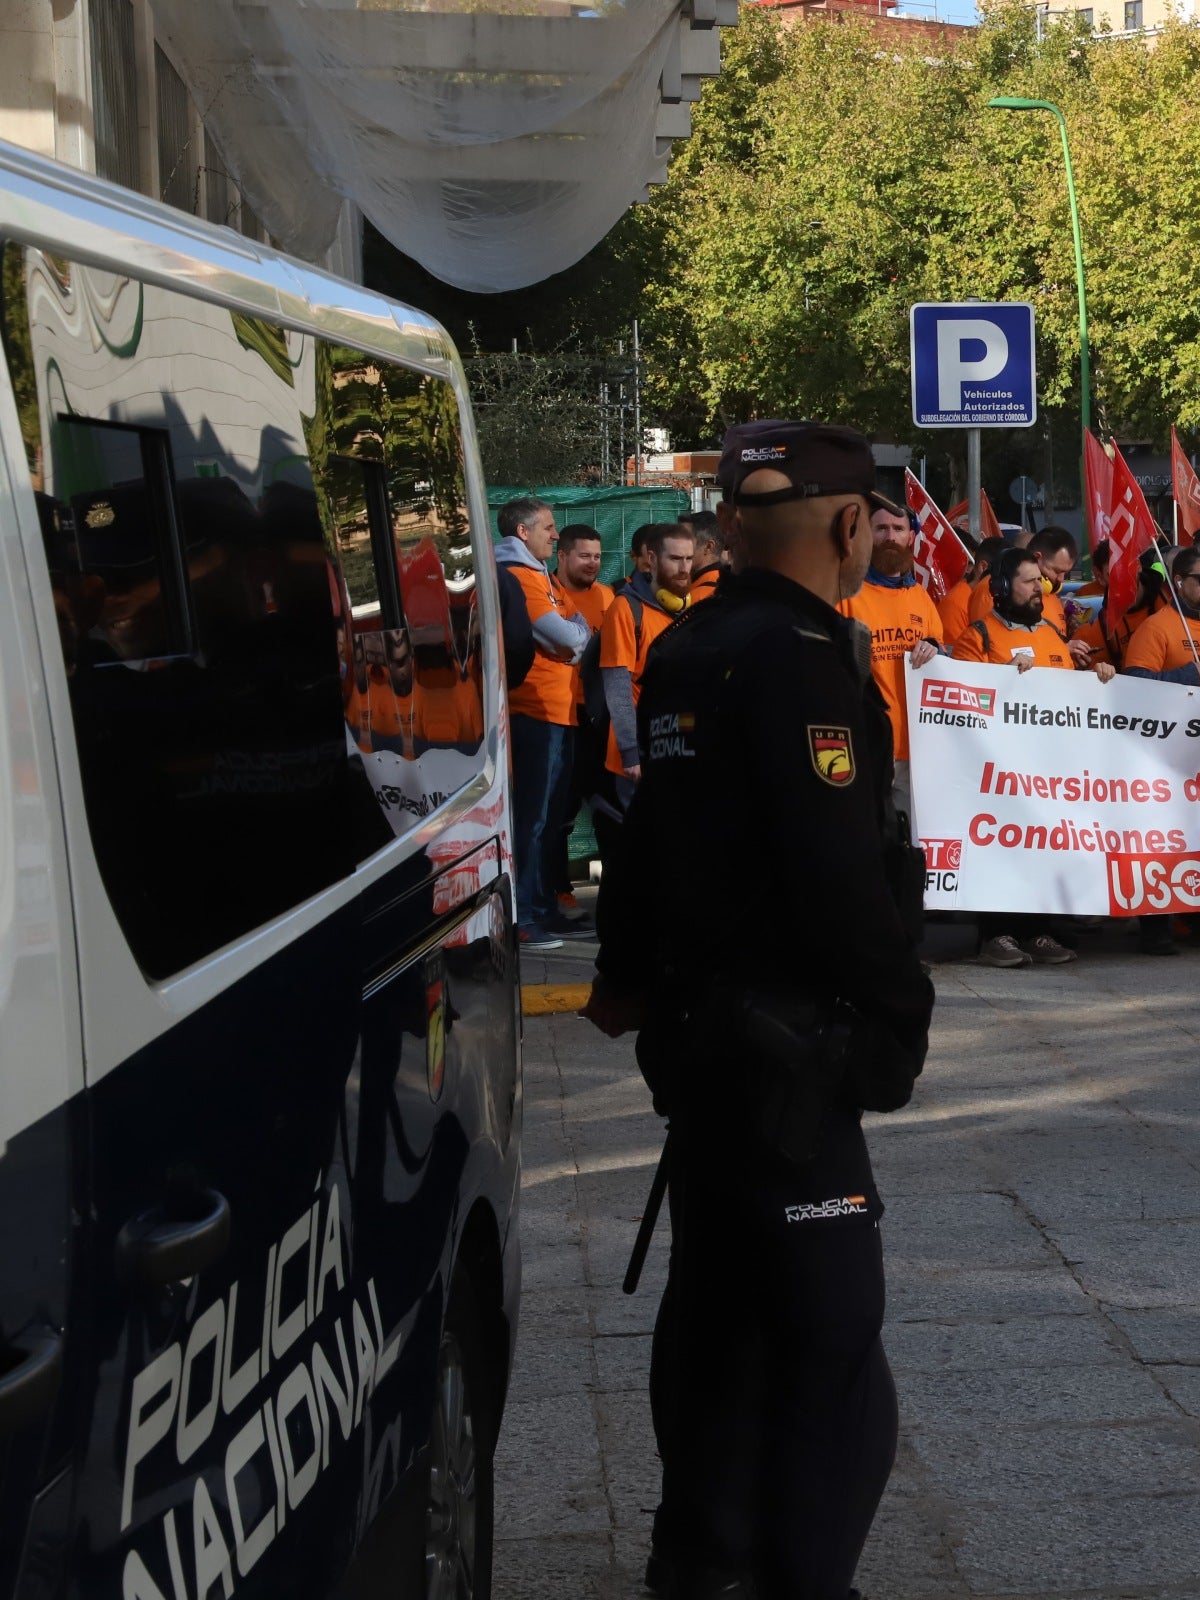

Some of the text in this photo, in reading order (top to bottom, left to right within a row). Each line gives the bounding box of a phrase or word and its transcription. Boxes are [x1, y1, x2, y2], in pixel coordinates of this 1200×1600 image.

[937, 319, 1008, 411] P
[964, 390, 1012, 399] Vehículos
[921, 412, 1028, 422] SUBDELEGACIÓN DEL GOBIERNO DE CÓRDOBA
[964, 402, 1025, 411] Autorizados
[926, 684, 980, 709] CCOO
[918, 708, 988, 730] industria
[1003, 702, 1081, 728] Hitachi
[1087, 708, 1177, 739] Energy
[979, 762, 1172, 803] Inversiones
[968, 813, 1187, 853] Condiciones
[785, 1197, 851, 1214] POLICIA
[787, 1205, 867, 1223] NACIONAL
